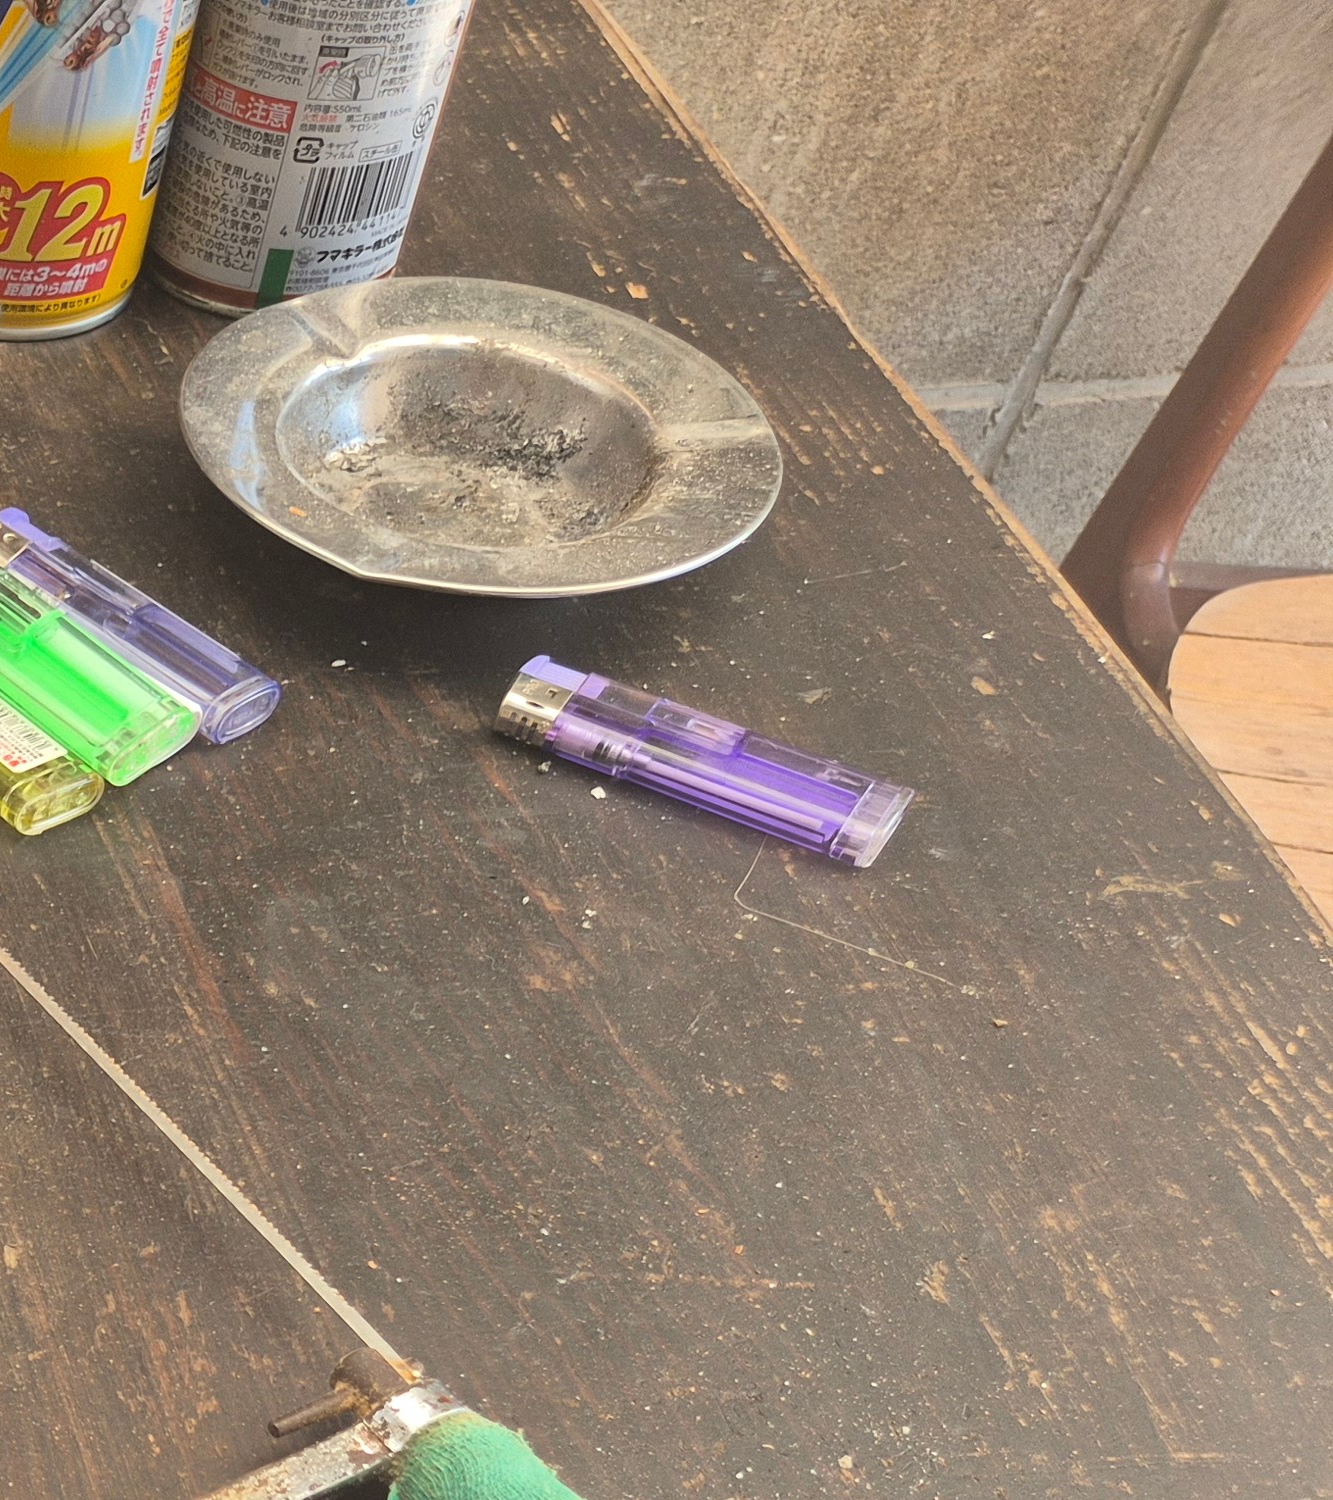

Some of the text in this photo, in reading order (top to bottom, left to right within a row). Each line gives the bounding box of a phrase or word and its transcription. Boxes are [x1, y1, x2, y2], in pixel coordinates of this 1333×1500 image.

[349, 122, 381, 133] ケロシン
[324, 149, 355, 161] フィルム
[279, 228, 288, 239] 4
[299, 223, 355, 240] 902424
[3, 278, 88, 298] 距離から噴射
